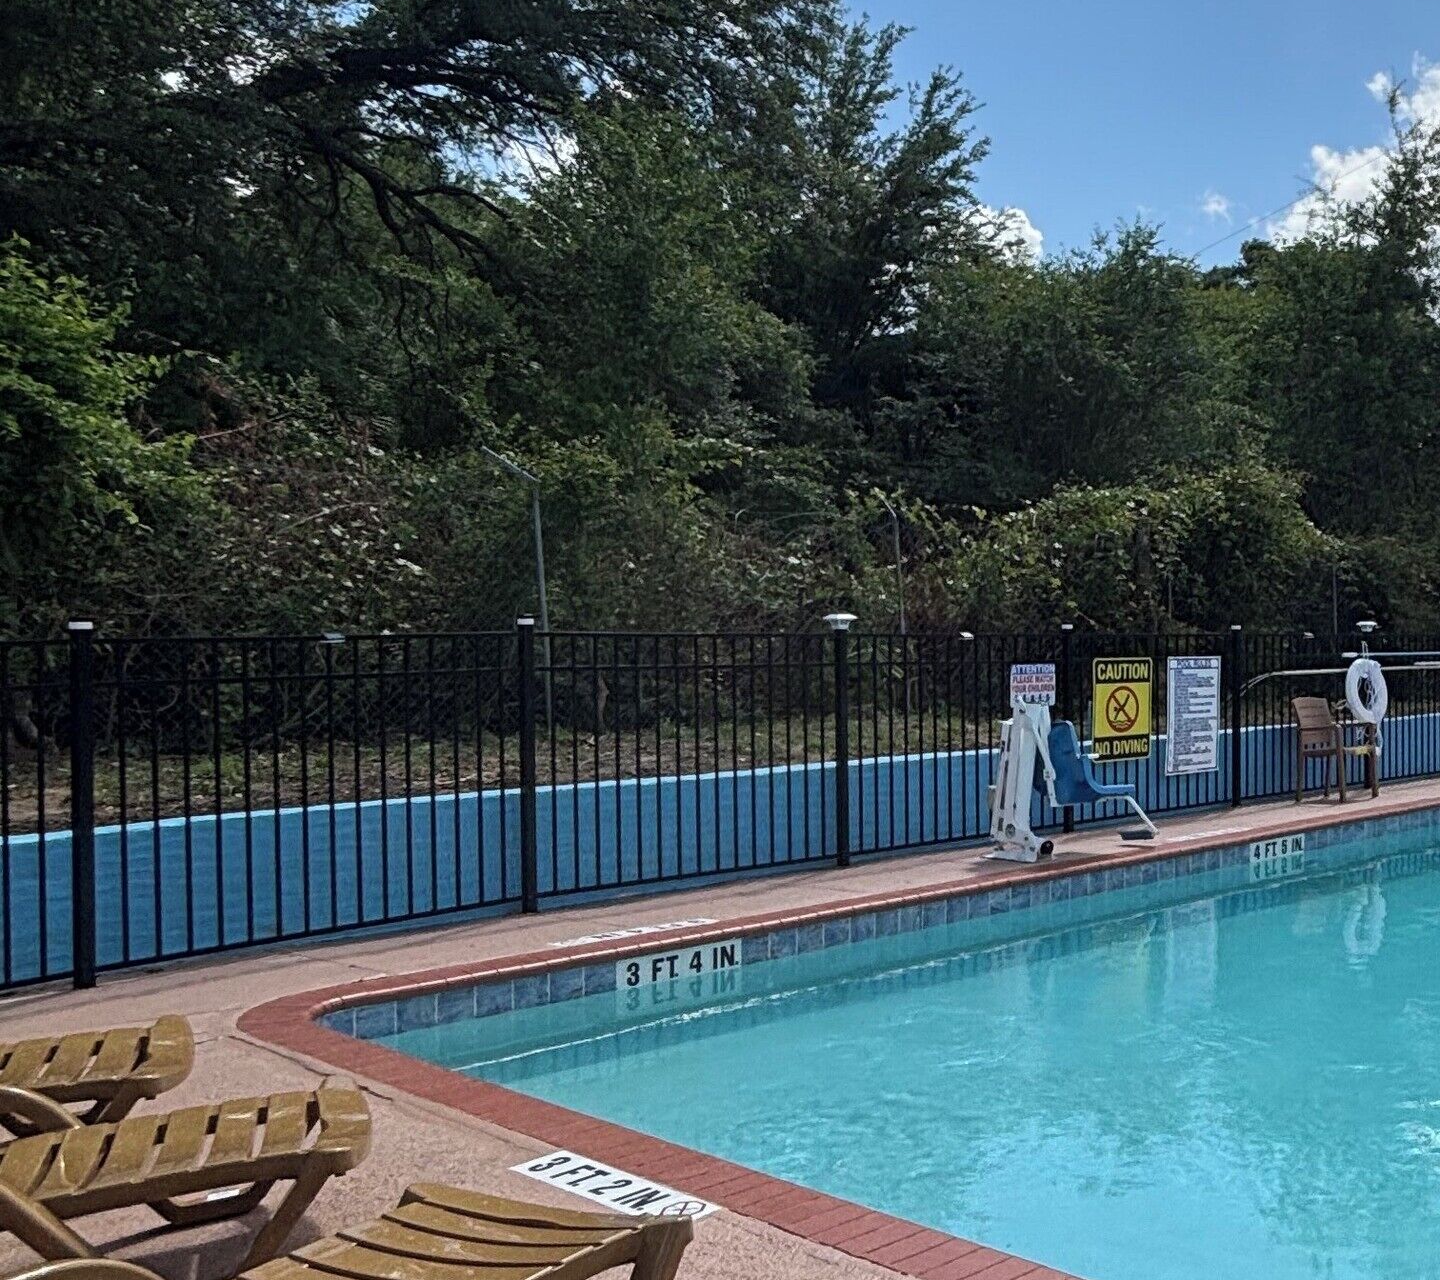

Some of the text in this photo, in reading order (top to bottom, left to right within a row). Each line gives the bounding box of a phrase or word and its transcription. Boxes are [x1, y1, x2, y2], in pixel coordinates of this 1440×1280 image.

[1012, 664, 1054, 674] ATTENTION
[1097, 663, 1148, 680] CAUTION
[1012, 675, 1034, 683] PLEASE
[1095, 738, 1148, 756] NO DIVING
[626, 944, 739, 986] 3 FT. 4 IN.
[528, 1156, 671, 1210] 3 FT. 2 IN.
